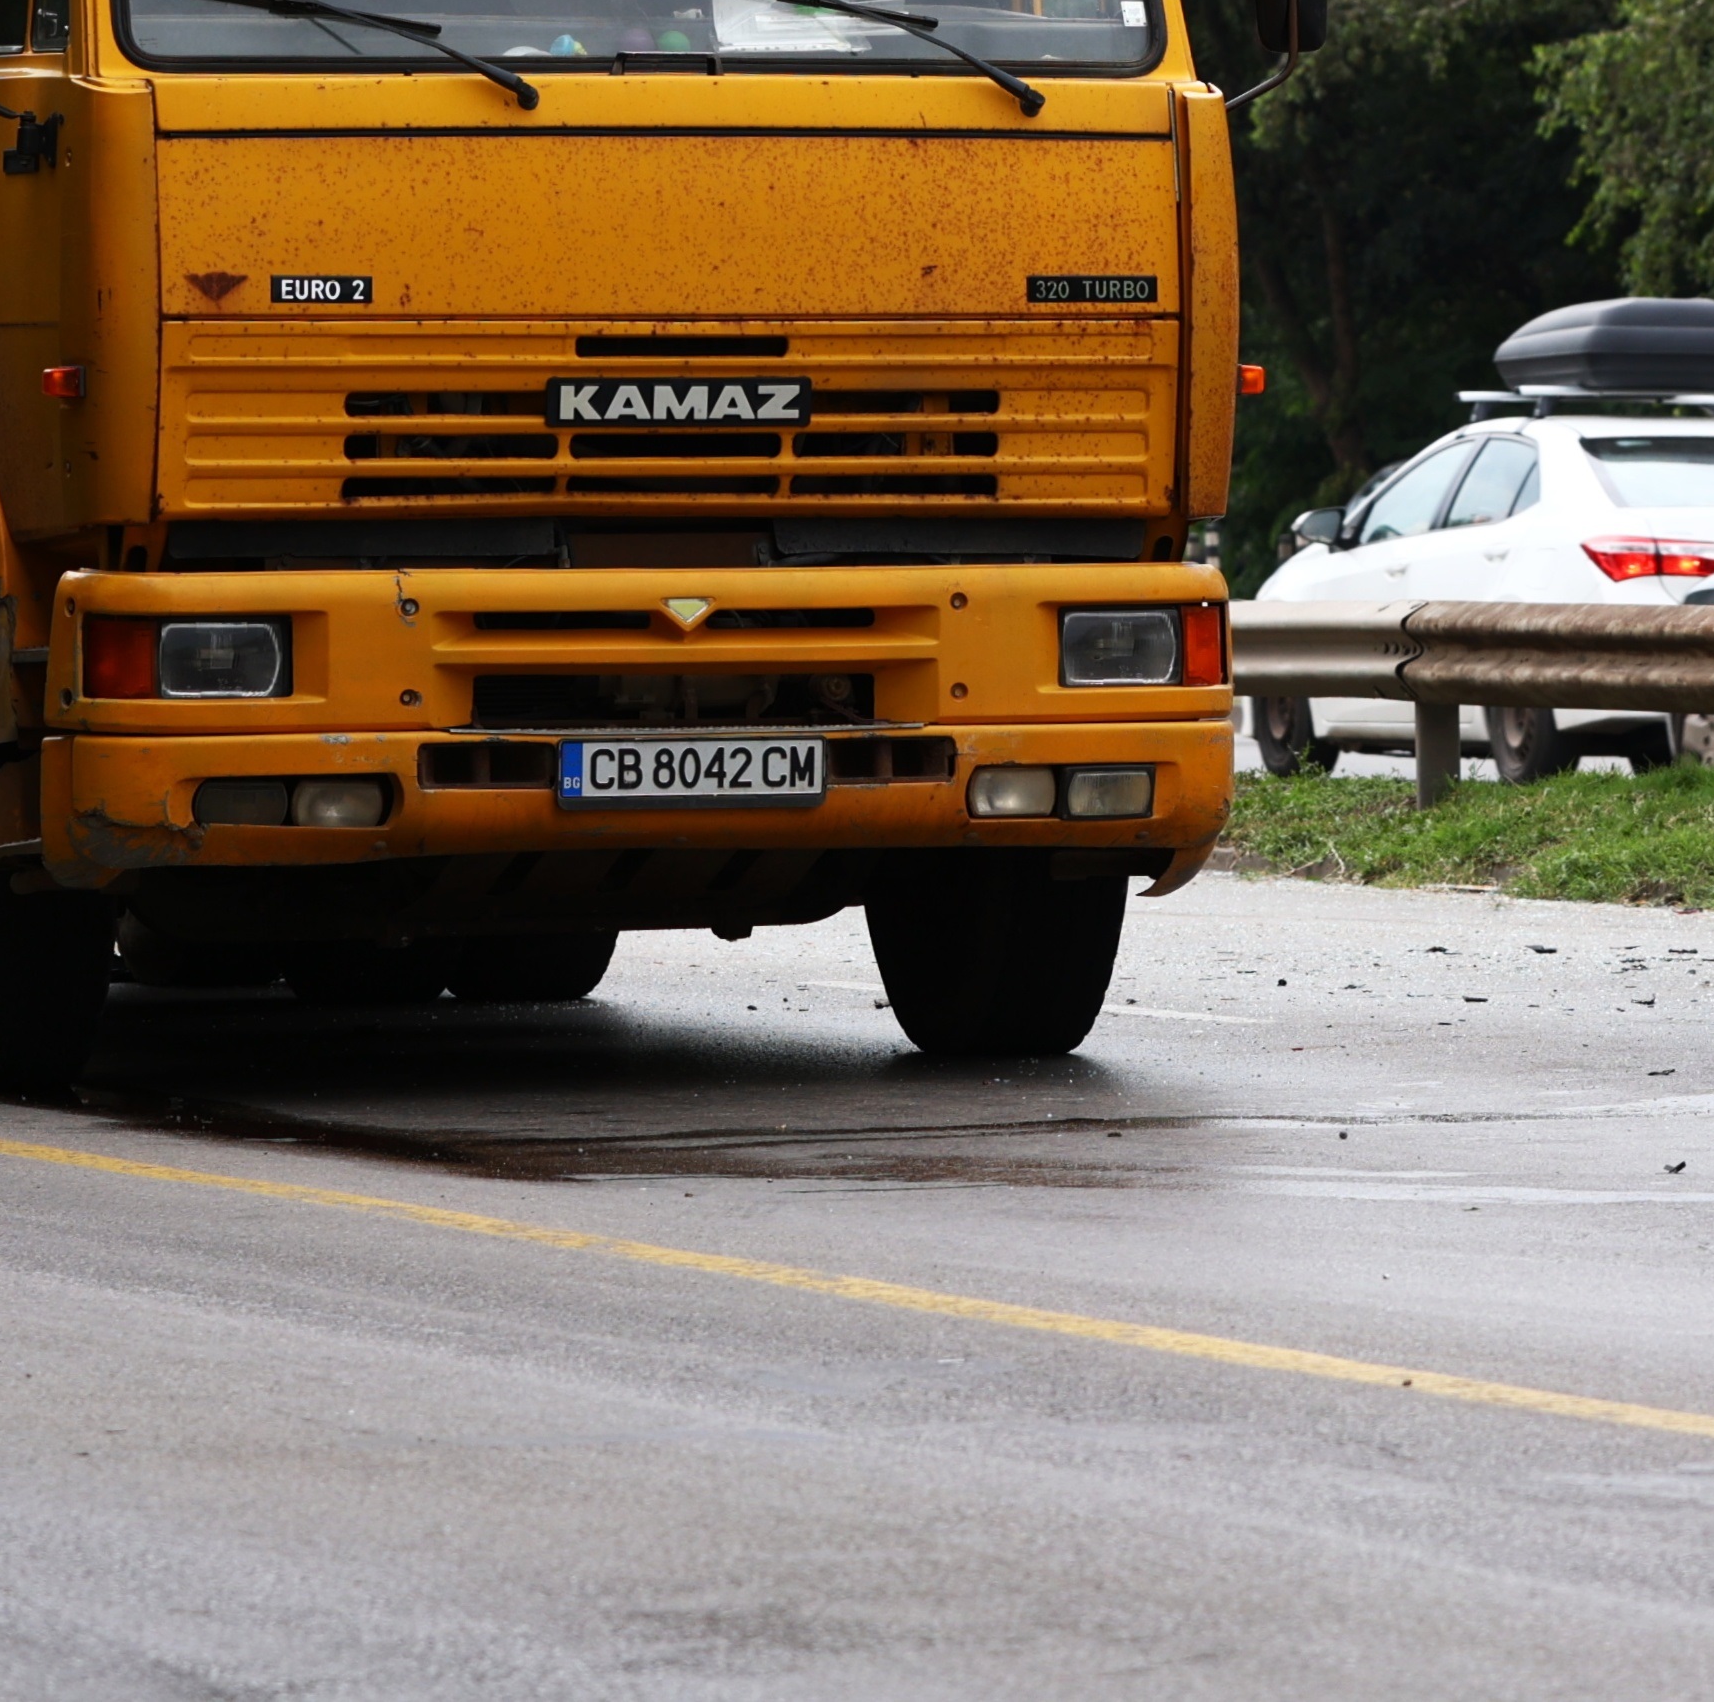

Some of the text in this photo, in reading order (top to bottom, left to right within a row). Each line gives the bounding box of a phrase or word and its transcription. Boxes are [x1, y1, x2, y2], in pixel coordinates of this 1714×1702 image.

[281, 279, 365, 300] EURO 2
[1035, 280, 1149, 299] 320 TURBO
[559, 384, 801, 420] KAMAZ
[590, 746, 815, 790] CB 8042 CM
[563, 777, 581, 789] BG
